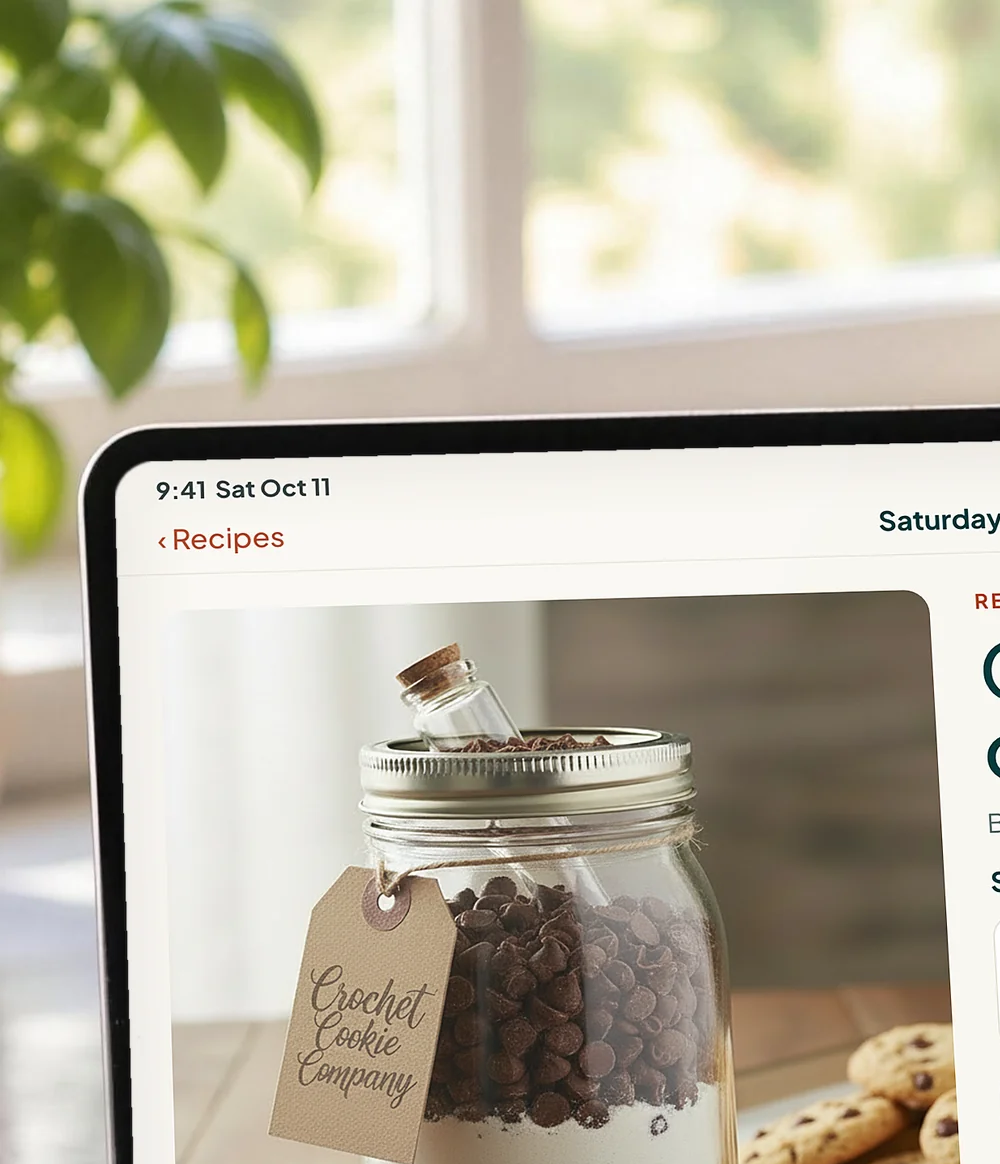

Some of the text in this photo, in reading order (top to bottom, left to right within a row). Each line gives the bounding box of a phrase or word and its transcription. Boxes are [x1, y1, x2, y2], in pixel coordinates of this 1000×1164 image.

[156, 477, 330, 501] 9:41 Sat Oct 11
[173, 527, 285, 555] Recipes
[310, 964, 439, 1030] Crochet
[313, 1010, 402, 1058] Cookie
[297, 1049, 418, 1109] Company
